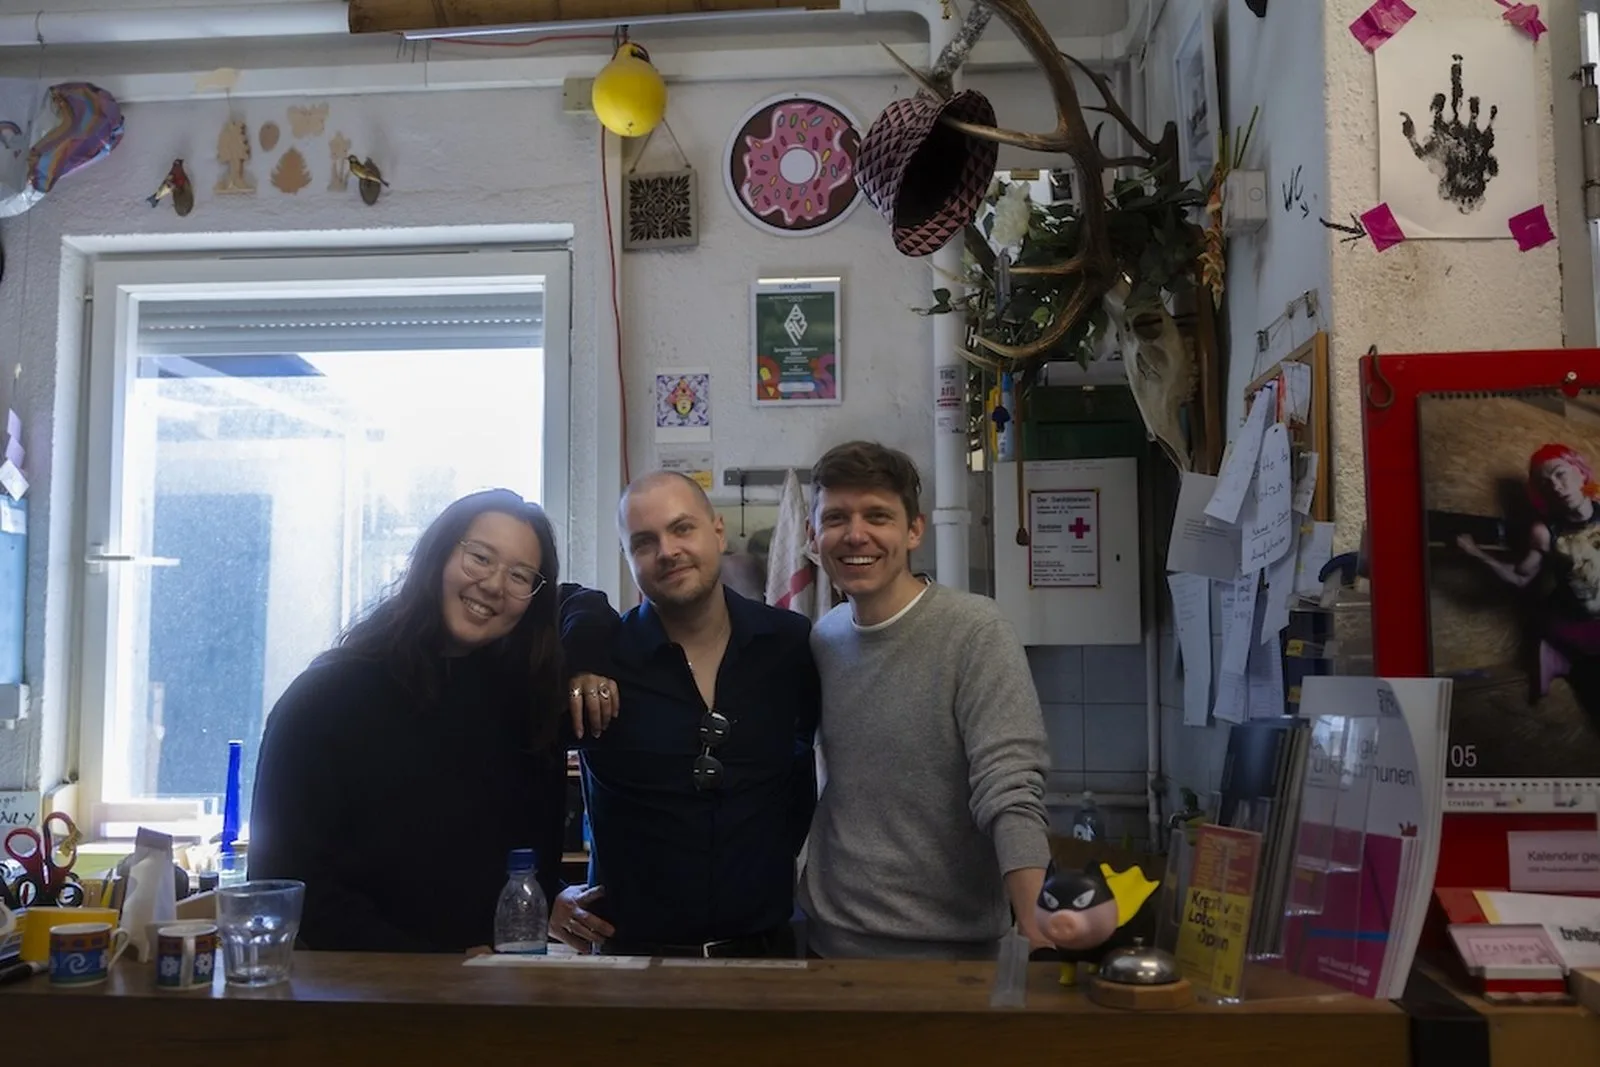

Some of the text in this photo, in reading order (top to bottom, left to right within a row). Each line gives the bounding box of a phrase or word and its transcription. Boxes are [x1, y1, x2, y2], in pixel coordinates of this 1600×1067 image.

[1282, 164, 1304, 213] WC
[1450, 745, 1478, 768] 05
[1527, 850, 1579, 862] Kalender
[1191, 890, 1231, 915] Kreatv
[1197, 928, 1229, 951] Opn
